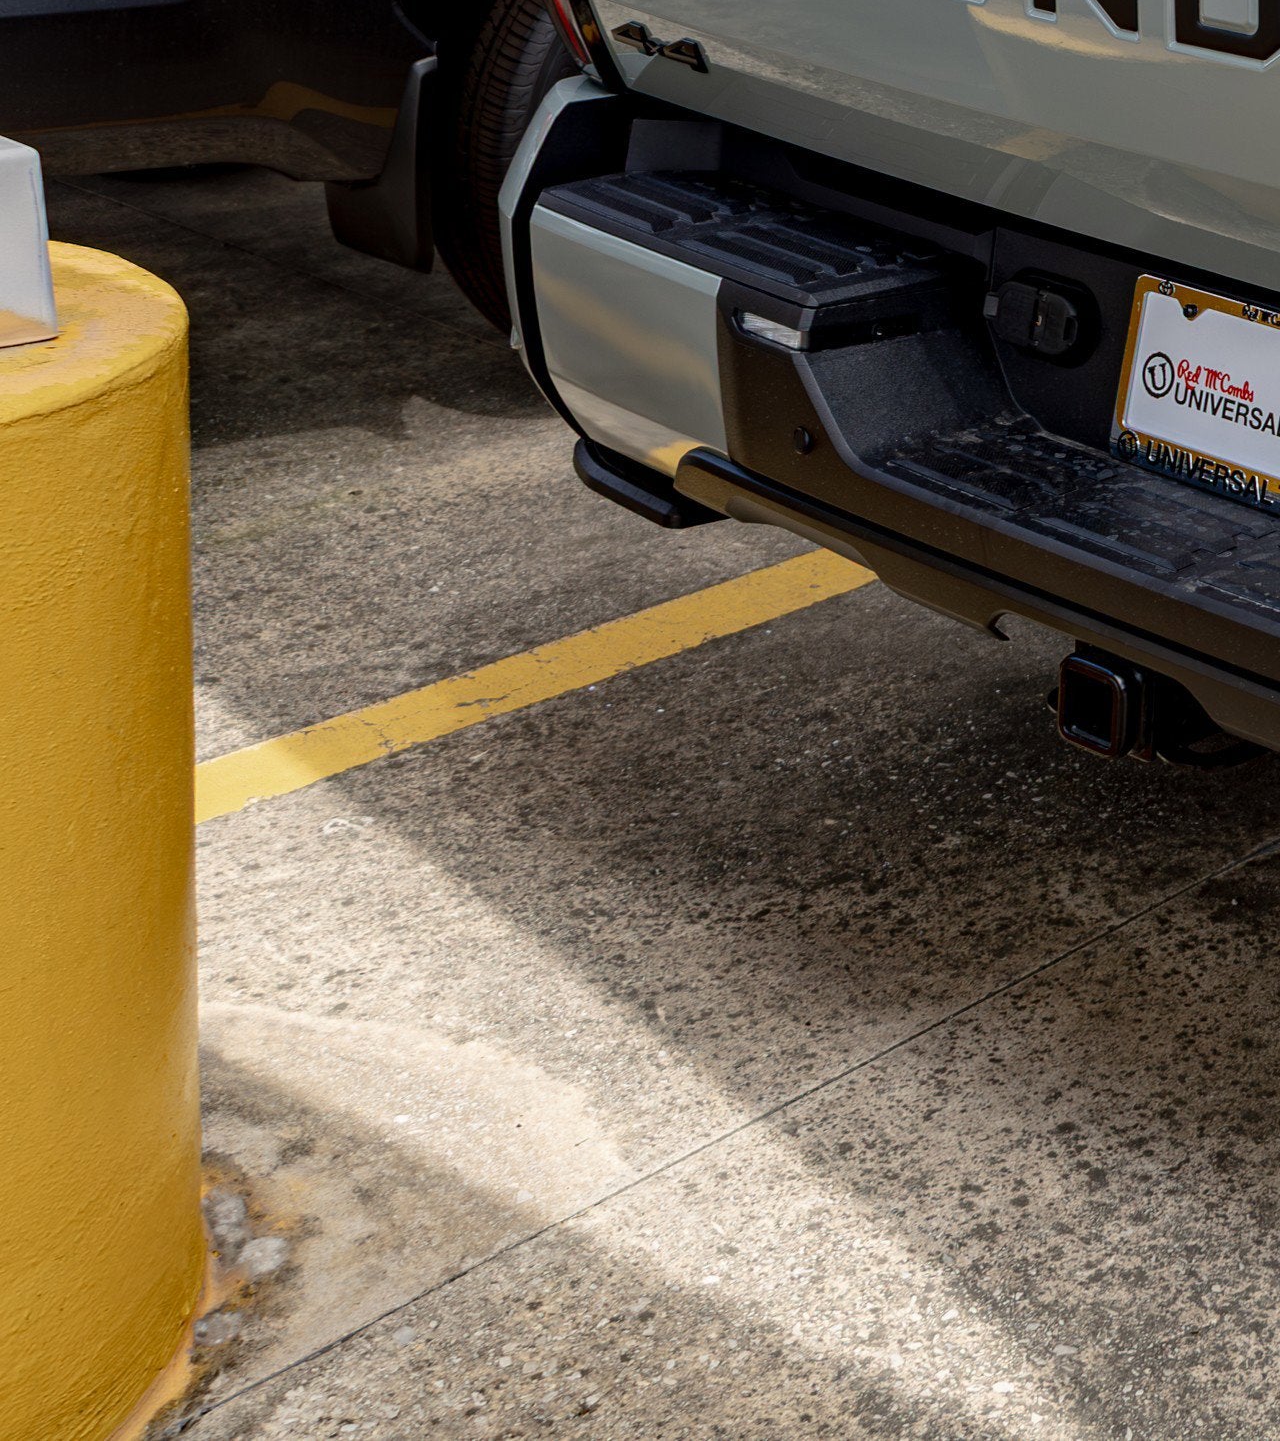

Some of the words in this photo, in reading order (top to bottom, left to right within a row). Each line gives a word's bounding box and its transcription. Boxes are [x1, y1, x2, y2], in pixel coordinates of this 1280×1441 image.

[1177, 359, 1202, 390] Red
[1203, 366, 1254, 403] McCombs
[1146, 439, 1274, 507] UNIVERSAL
